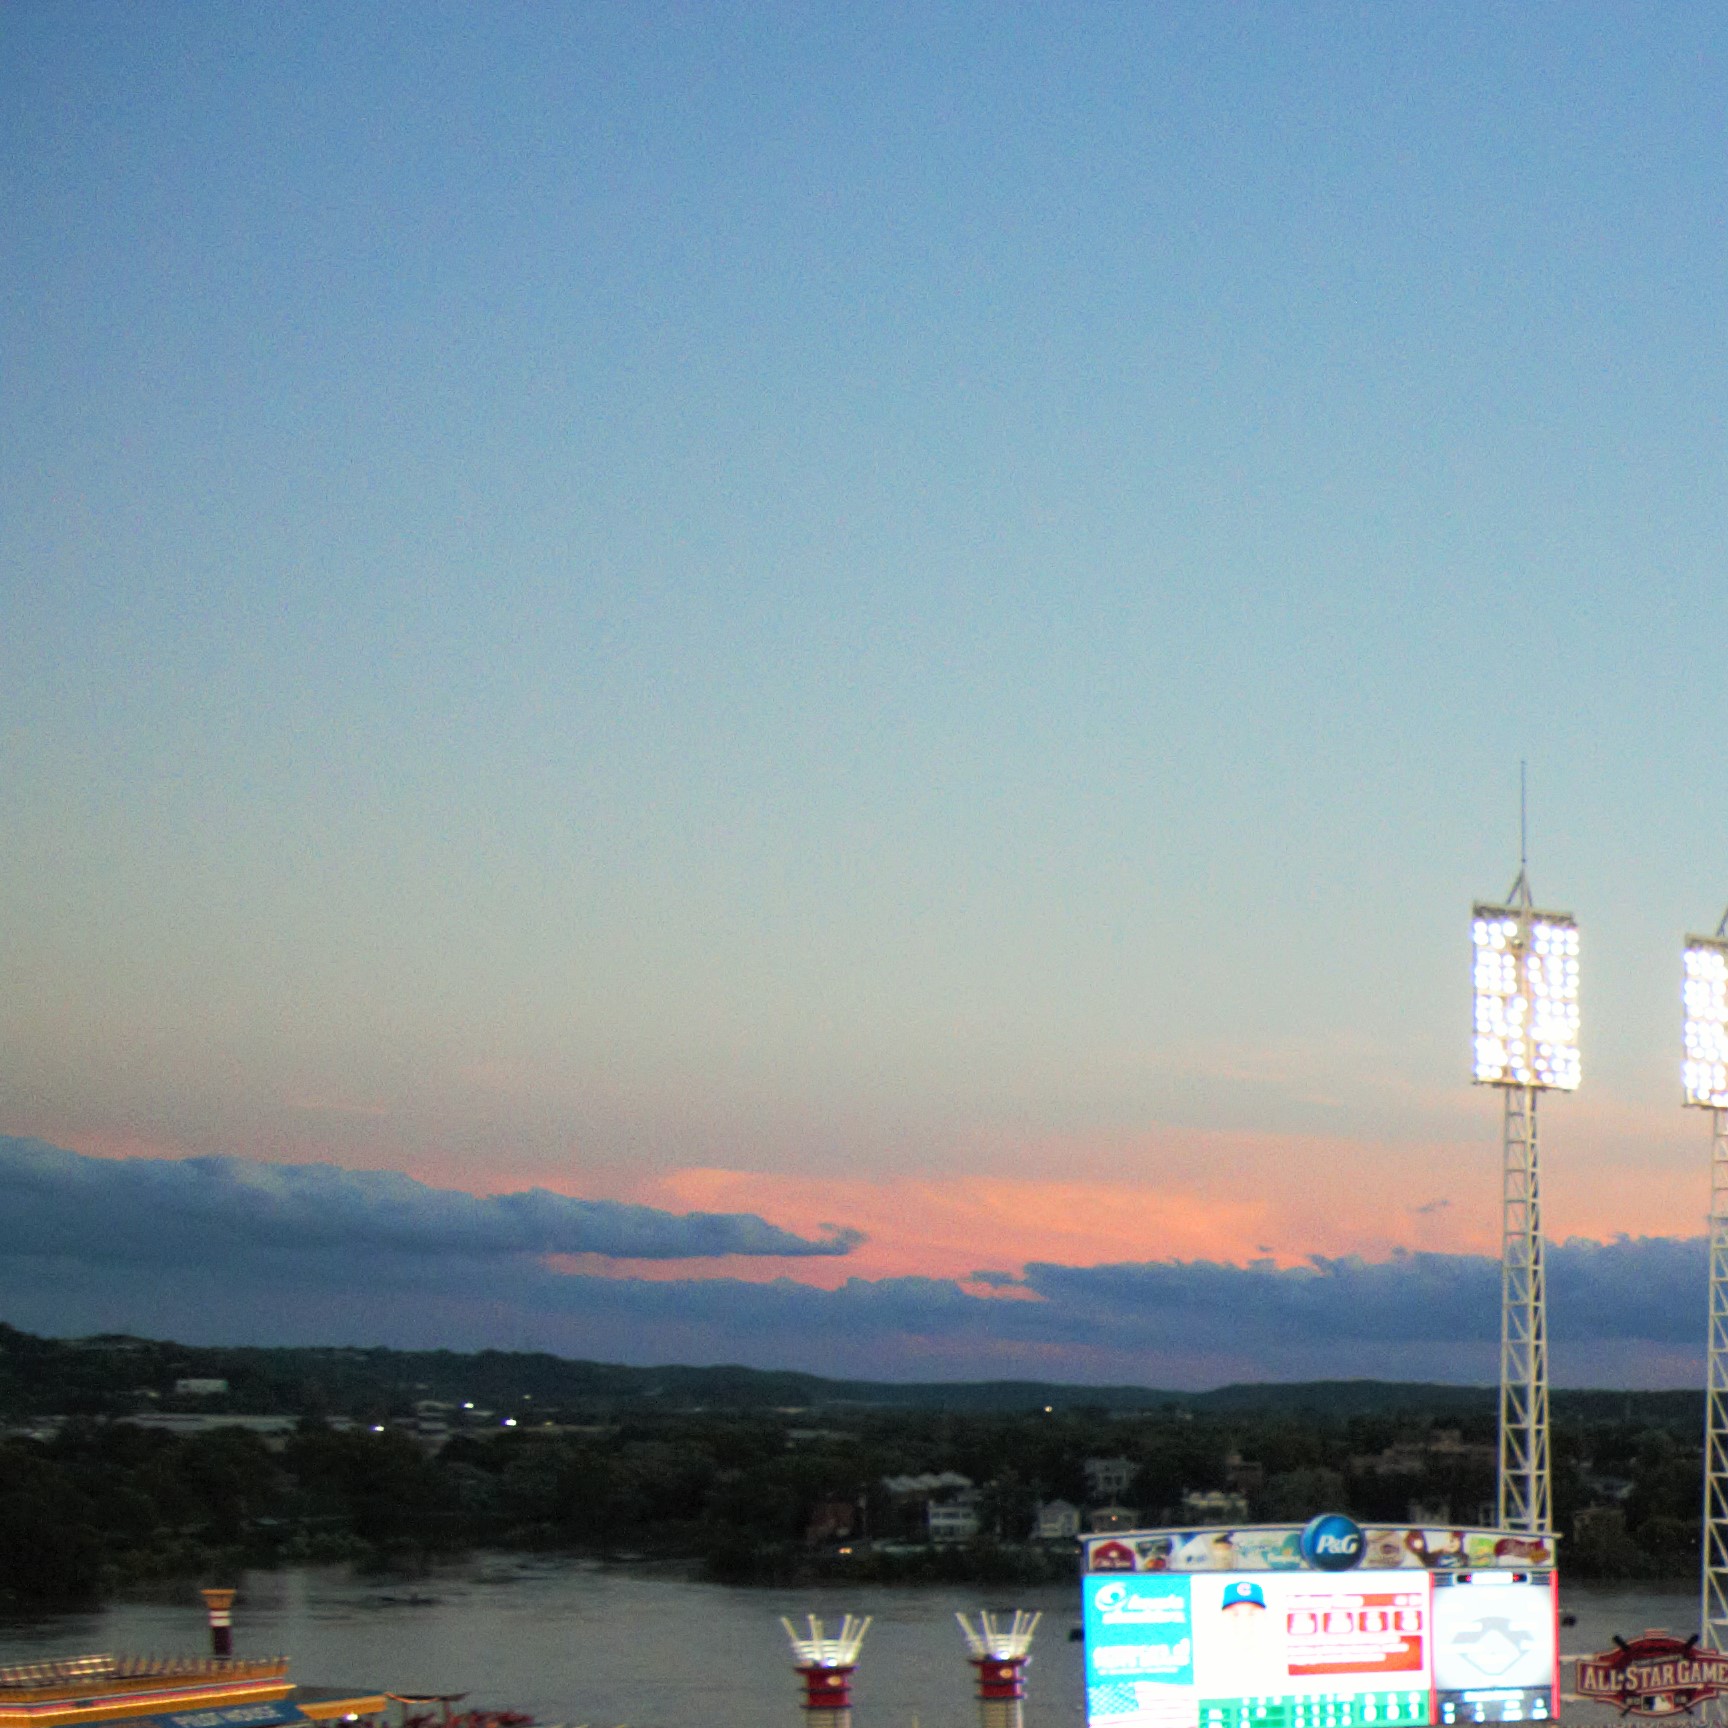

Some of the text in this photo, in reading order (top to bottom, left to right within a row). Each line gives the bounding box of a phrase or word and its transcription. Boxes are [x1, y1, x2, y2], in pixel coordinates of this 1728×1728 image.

[1315, 1533, 1359, 1556] P&G
[1584, 1666, 1618, 1691] ALL
[1625, 1664, 1674, 1691] STAR
